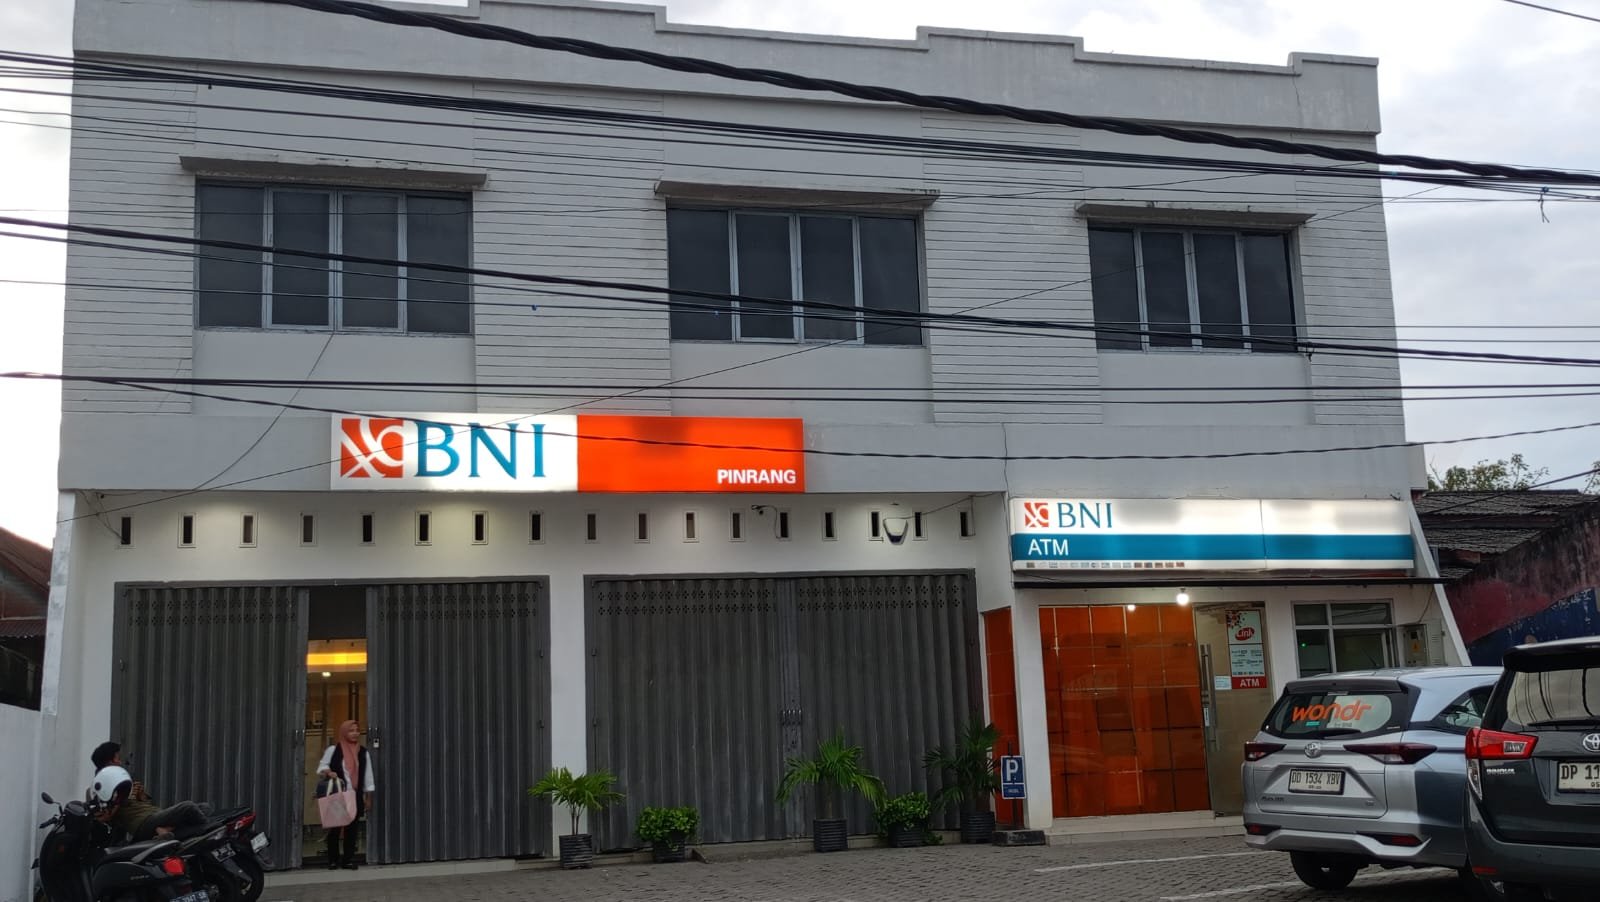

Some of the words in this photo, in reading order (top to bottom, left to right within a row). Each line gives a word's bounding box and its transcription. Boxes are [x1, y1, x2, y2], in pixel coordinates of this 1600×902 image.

[414, 422, 547, 479] BNI
[717, 469, 796, 485] PINRANG
[1057, 502, 1113, 528] BNI
[1028, 538, 1069, 556] ATM
[1240, 678, 1260, 688] ATM
[1291, 700, 1372, 722] wondr
[1006, 759, 1019, 781] P
[1561, 764, 1578, 780] DP
